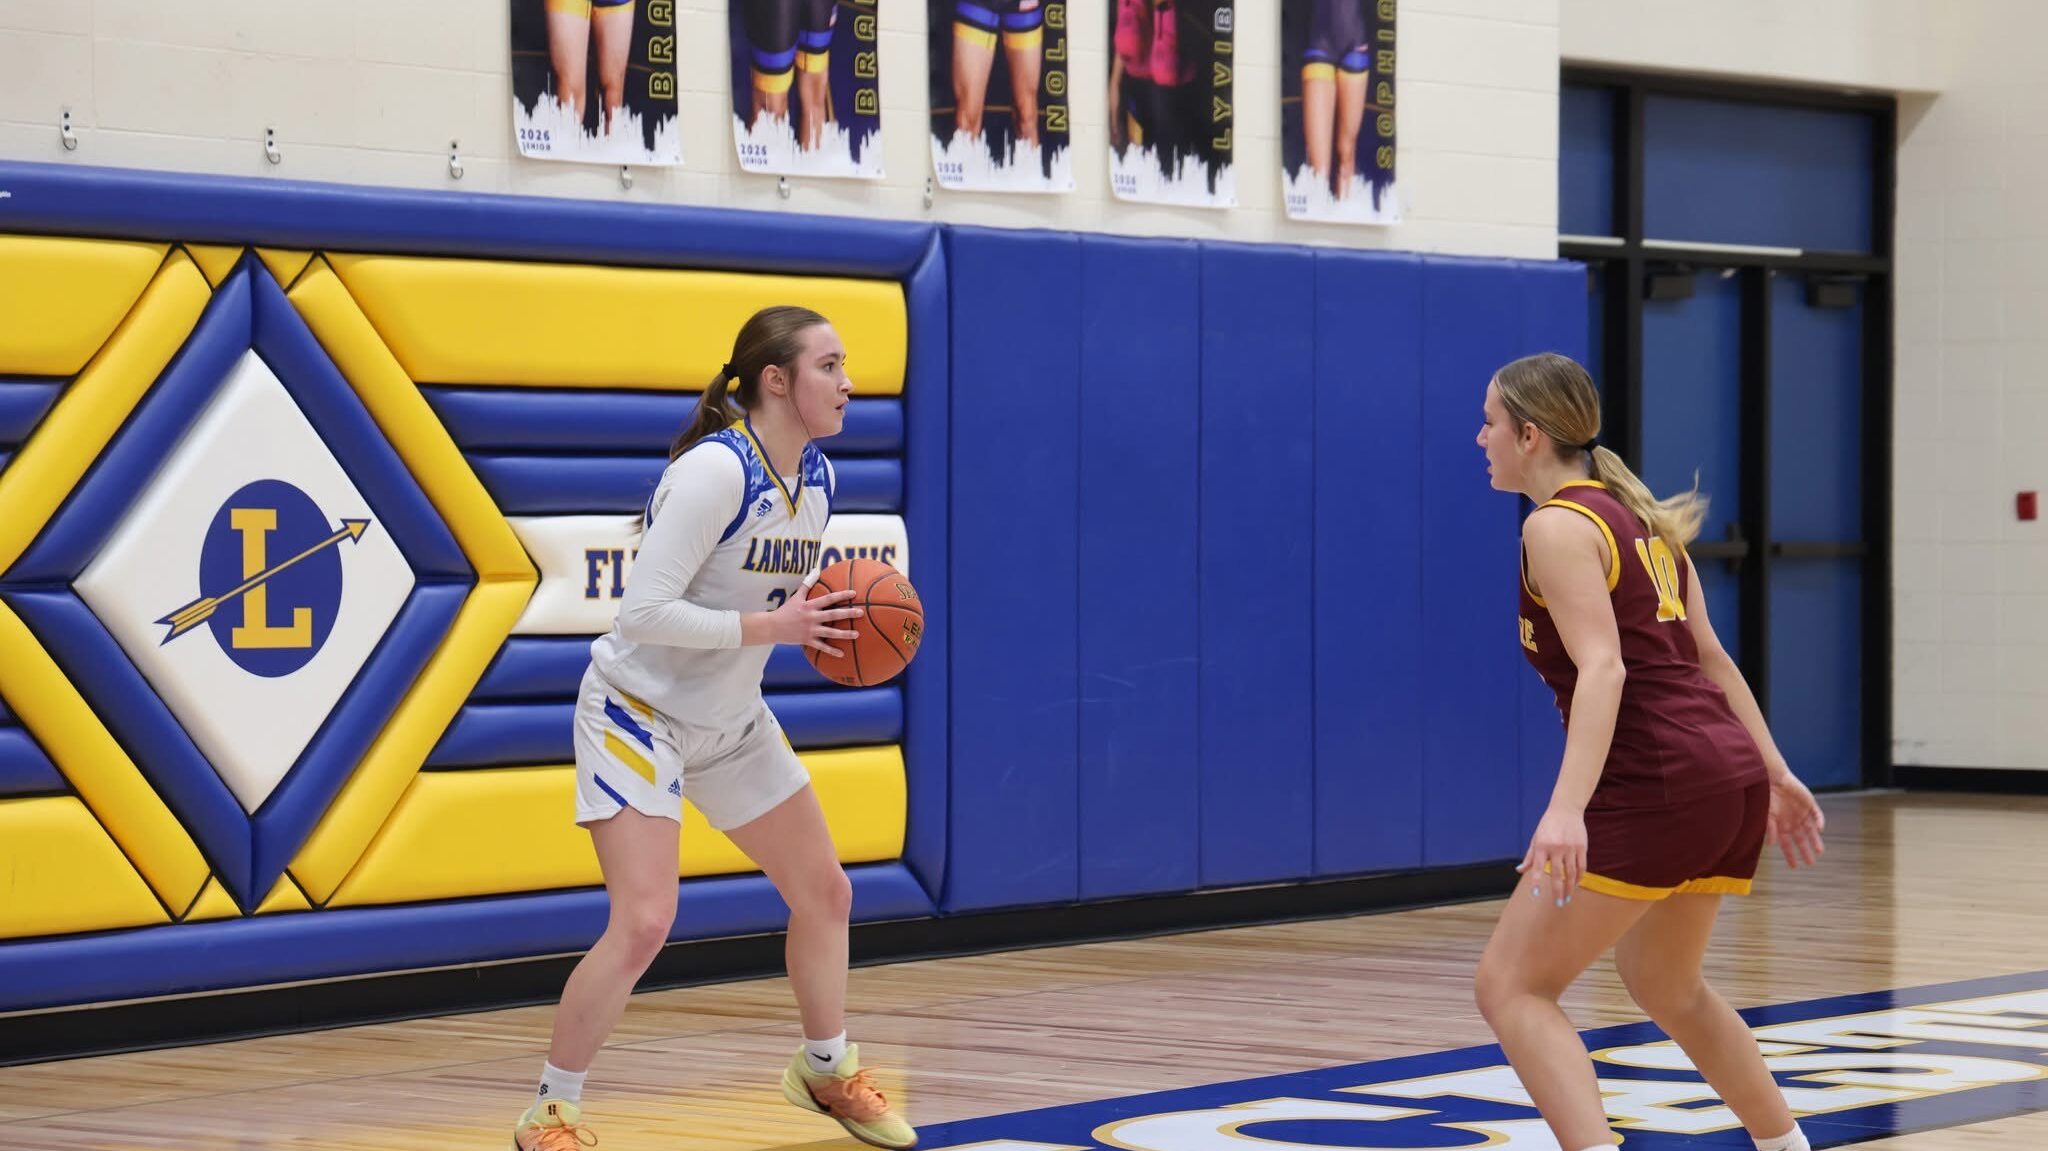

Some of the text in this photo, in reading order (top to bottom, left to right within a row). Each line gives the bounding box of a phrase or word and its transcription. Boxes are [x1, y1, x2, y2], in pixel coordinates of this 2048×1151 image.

[854, 0, 878, 115] BRA
[1045, 4, 1068, 132] NOLA
[1377, 0, 1395, 169] SOPHIA
[520, 128, 550, 142] 2026
[741, 143, 767, 156] 2026
[230, 507, 313, 650] L
[1635, 536, 1687, 622] 10
